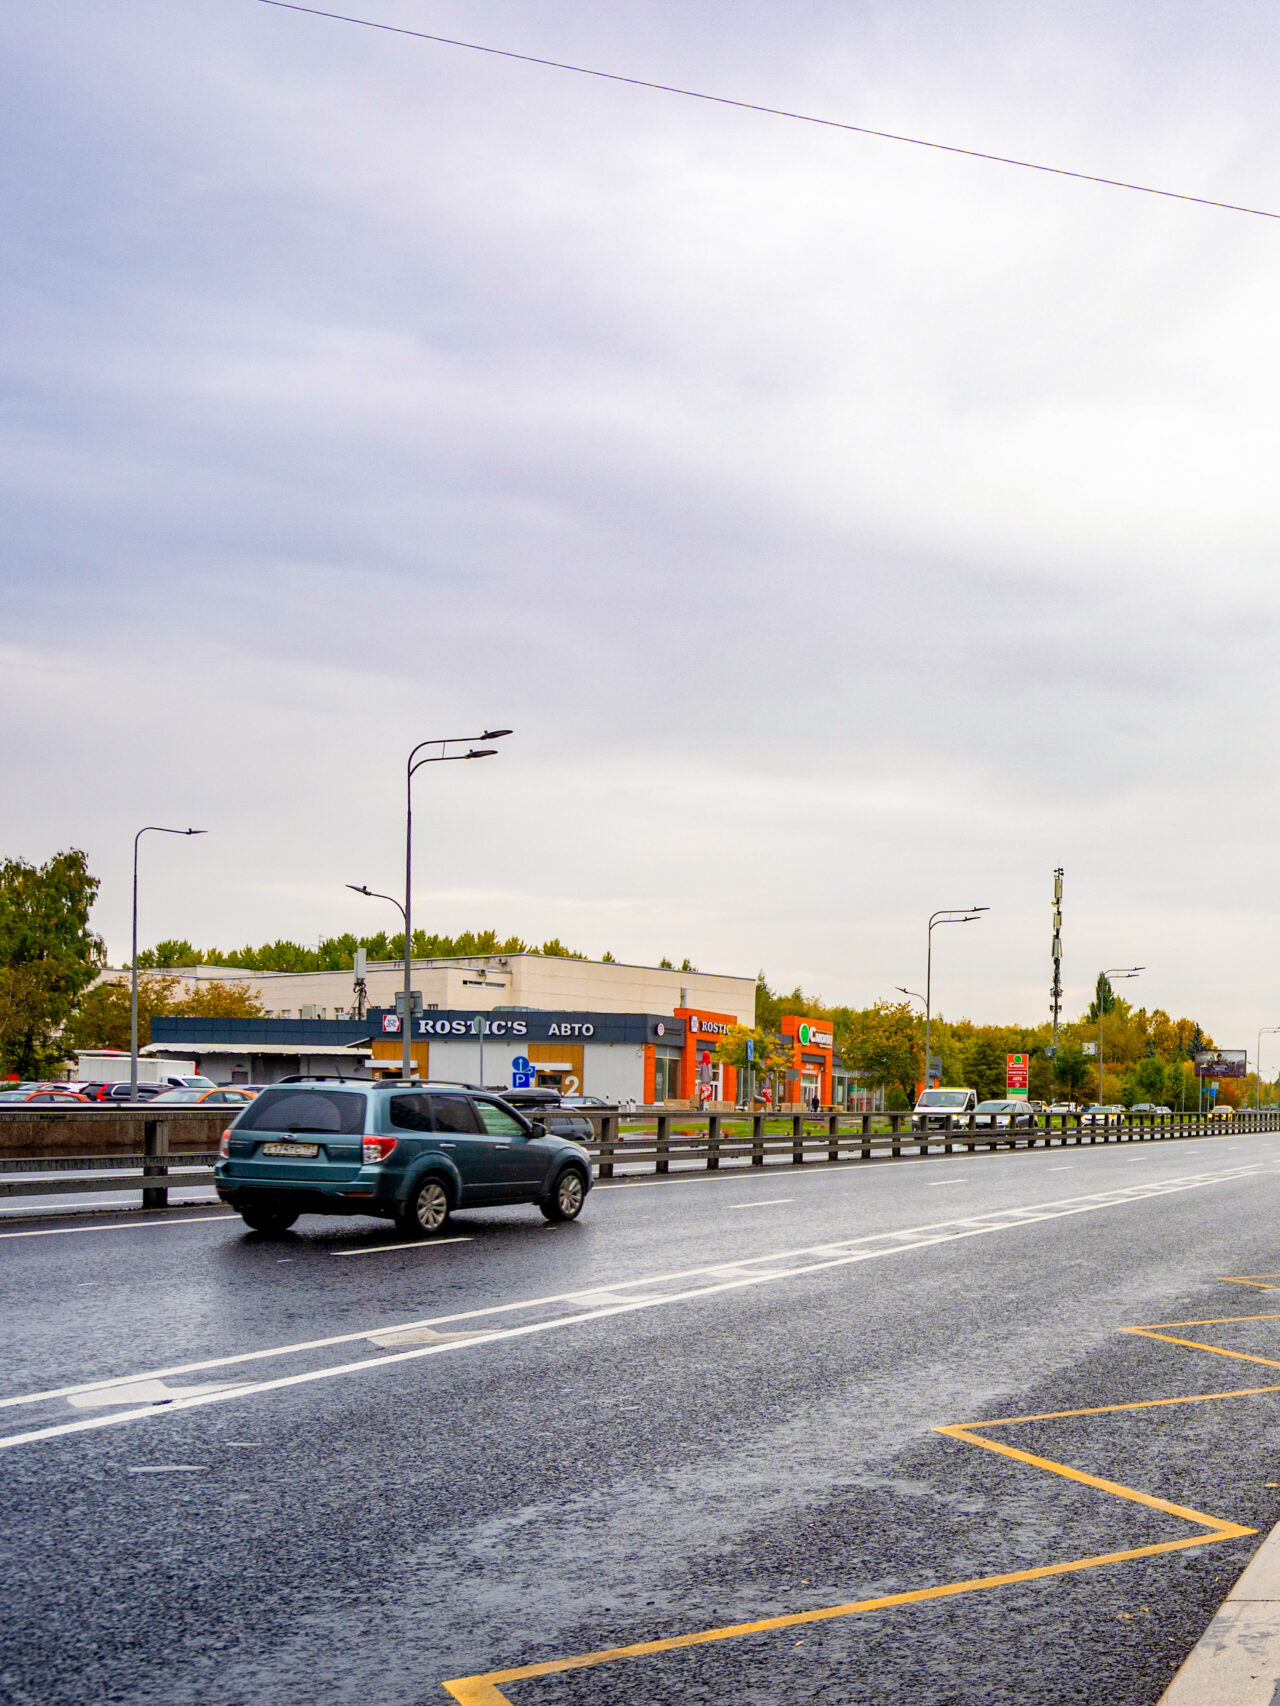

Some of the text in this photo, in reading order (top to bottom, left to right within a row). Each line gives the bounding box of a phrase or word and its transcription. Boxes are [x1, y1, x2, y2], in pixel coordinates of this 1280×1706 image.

[418, 1020, 528, 1035] ROSTIC'S
[548, 1023, 595, 1036] АВТО
[701, 1020, 733, 1035] ROSTIC
[564, 1075, 580, 1097] 2
